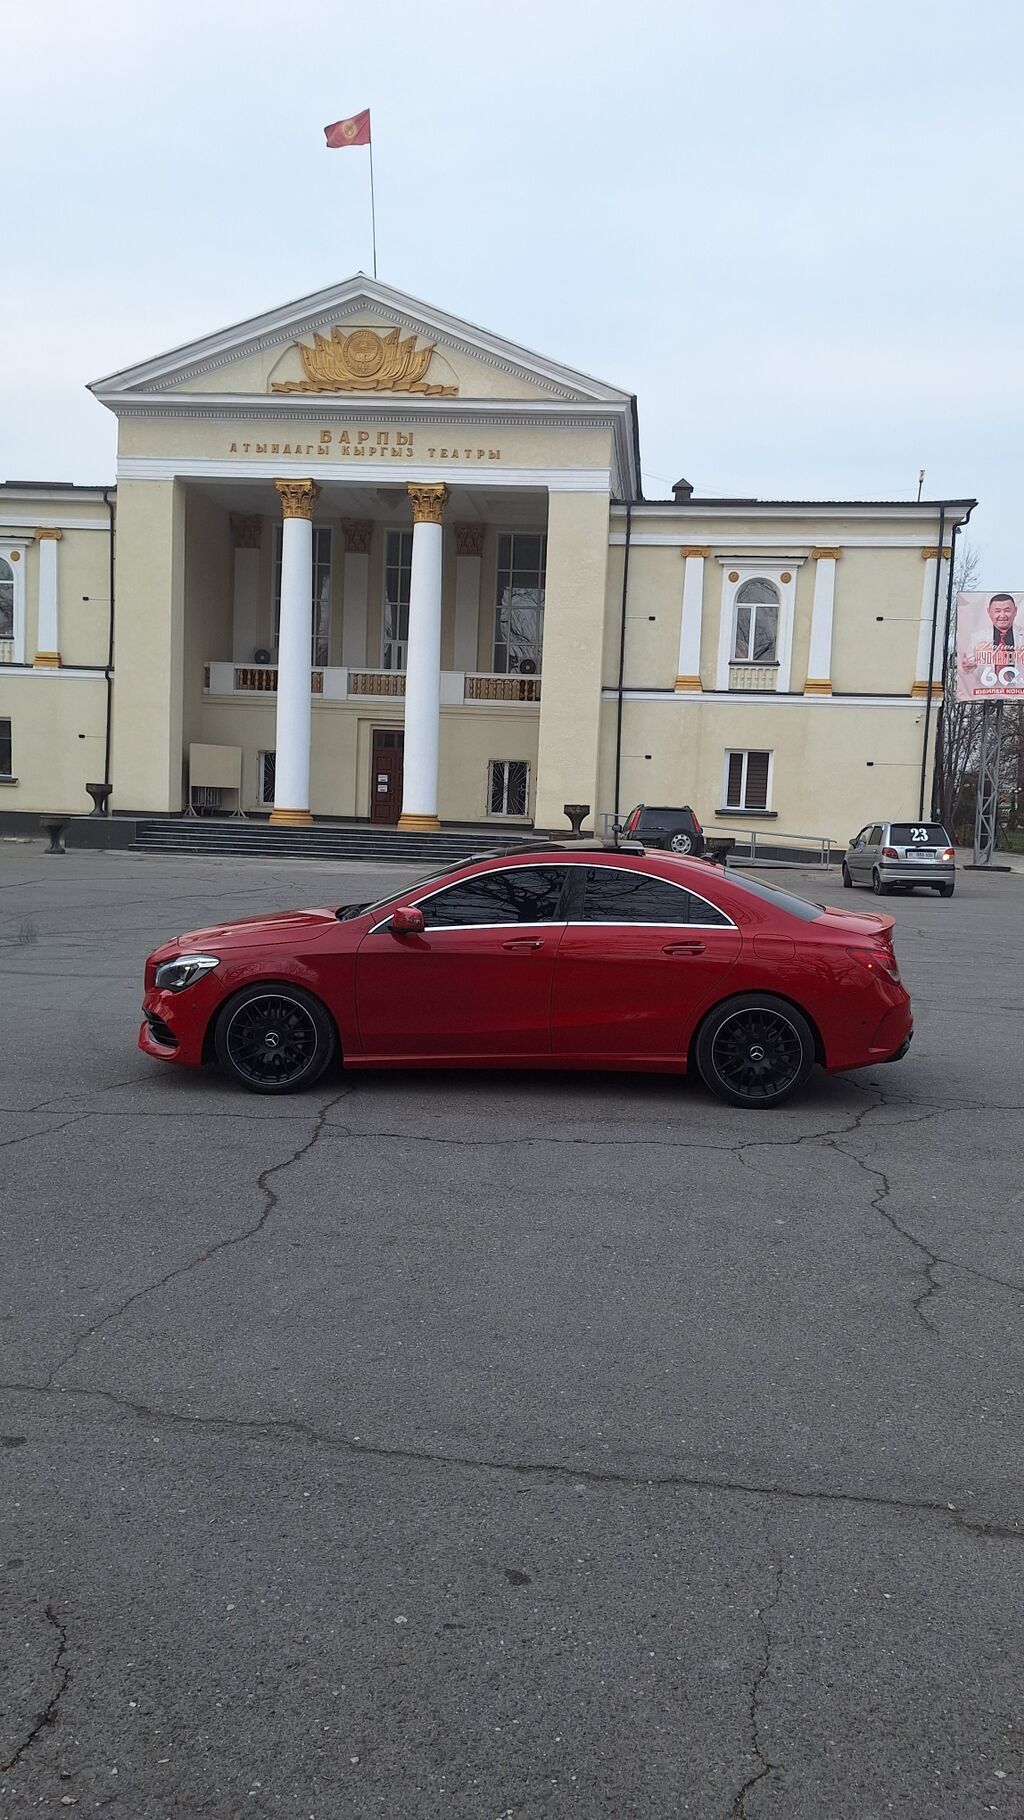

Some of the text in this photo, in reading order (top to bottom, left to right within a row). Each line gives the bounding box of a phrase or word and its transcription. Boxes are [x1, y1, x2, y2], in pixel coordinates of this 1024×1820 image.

[320, 430, 414, 446] БАРПЫ
[229, 442, 501, 460] АТЫНДАГЫ КЫРГЫЗ ТЕАТРЫ
[980, 666, 1020, 686] 60
[910, 828, 929, 842] 23
